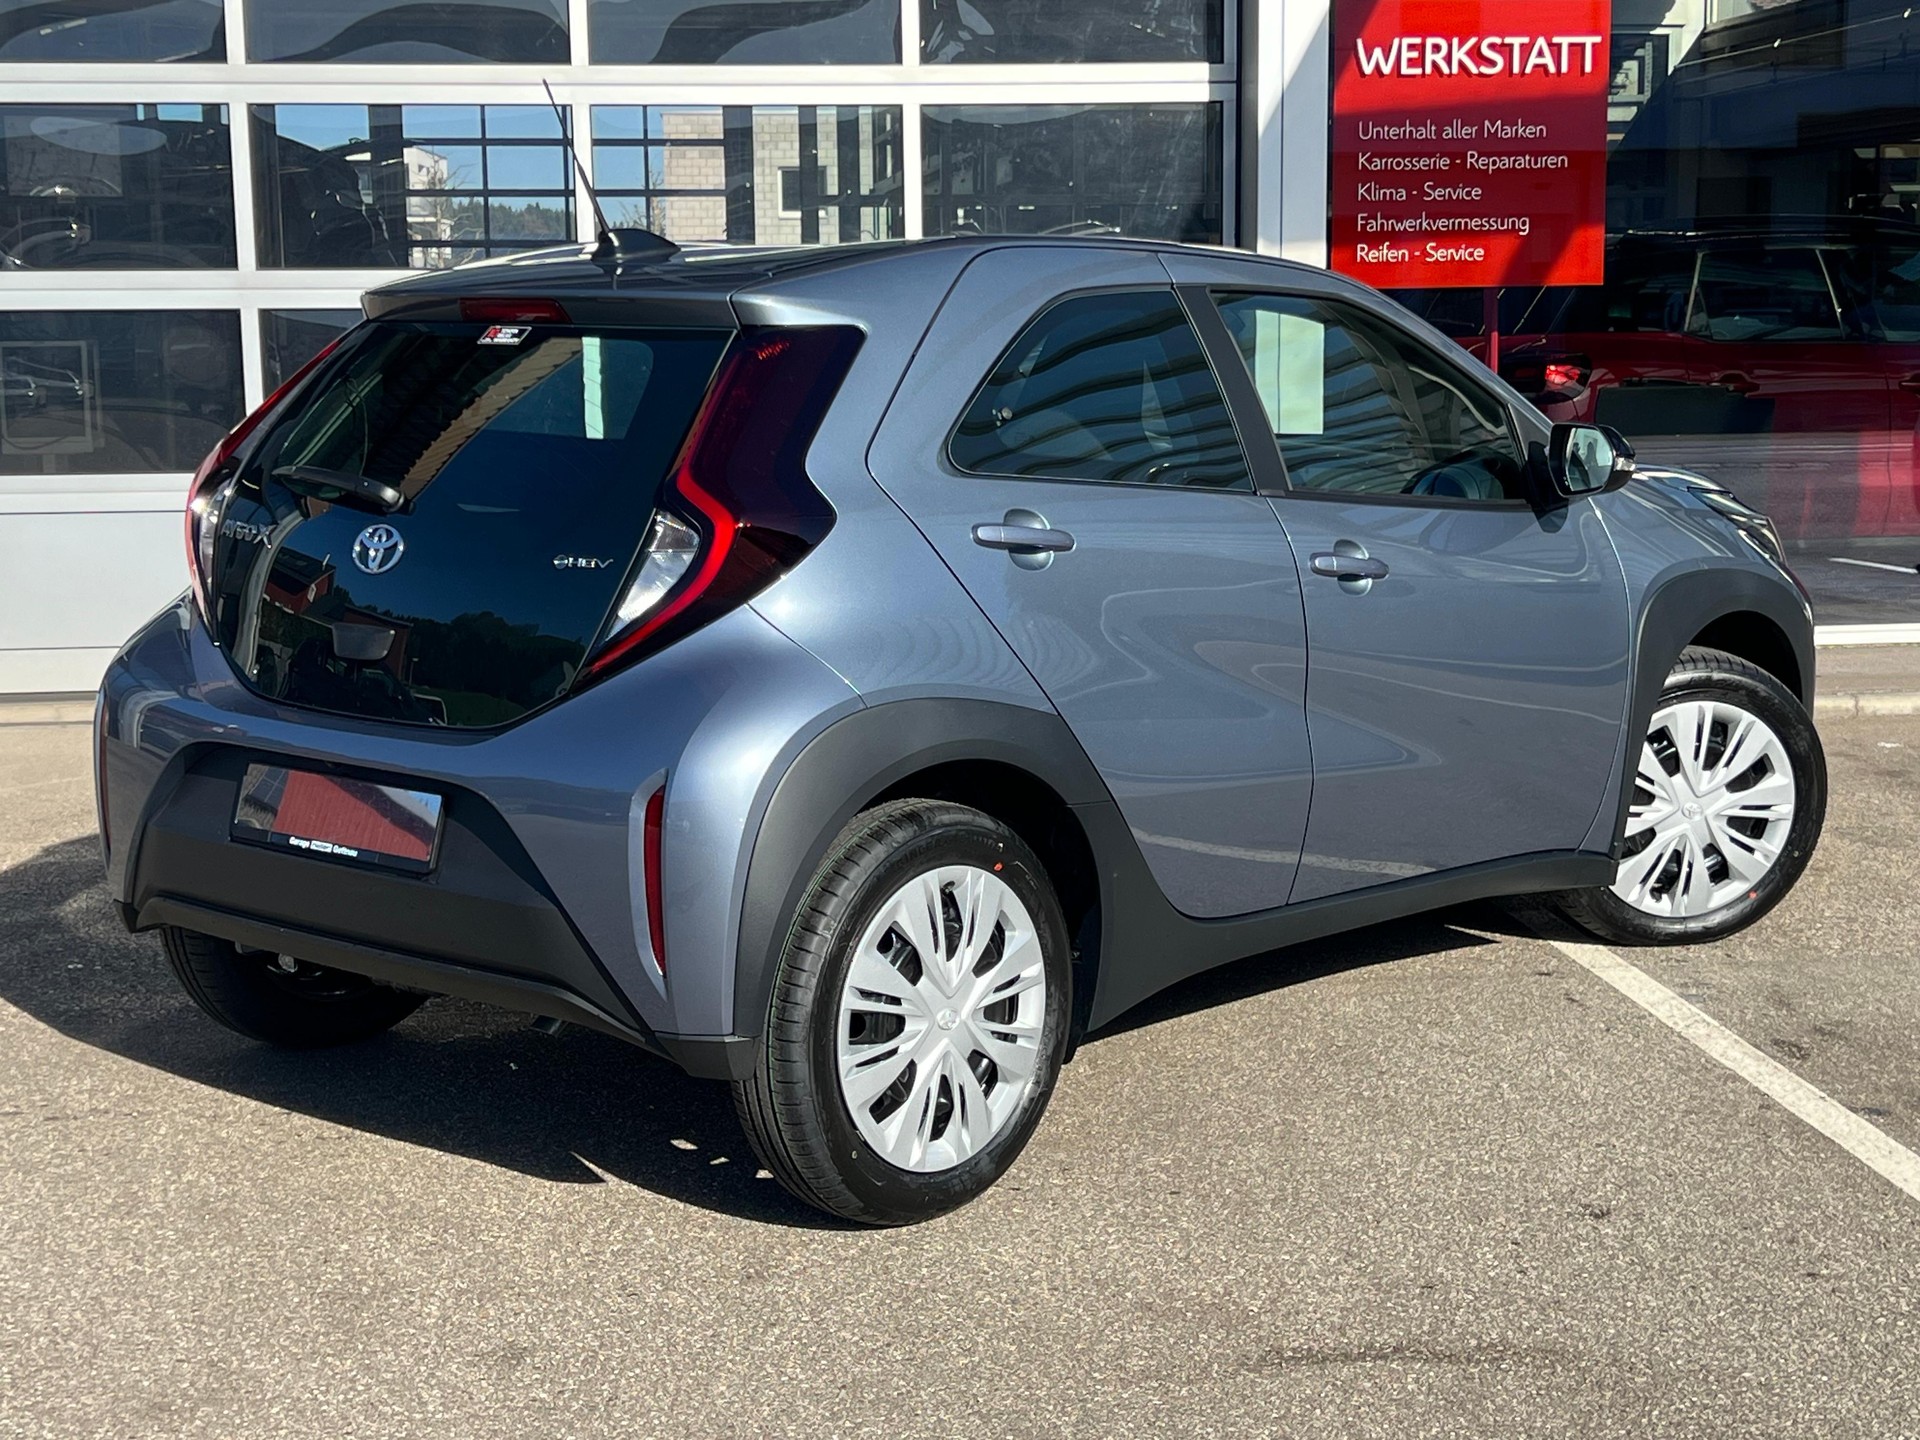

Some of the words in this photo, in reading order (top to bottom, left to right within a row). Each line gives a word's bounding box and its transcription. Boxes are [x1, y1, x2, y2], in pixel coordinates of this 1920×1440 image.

[1356, 35, 1602, 76] WERKSTATT
[1358, 119, 1437, 140] Unterhalt
[1442, 118, 1478, 139] aller
[1484, 118, 1547, 138] Marken
[1358, 152, 1450, 171] Karrosserie
[1467, 151, 1568, 174] Reparaturen
[1357, 182, 1406, 202] Klima
[1423, 182, 1482, 201] Service
[1357, 212, 1530, 235] Fahrwerkvermessung
[1356, 242, 1409, 263] Reifen
[1425, 242, 1485, 262] Service
